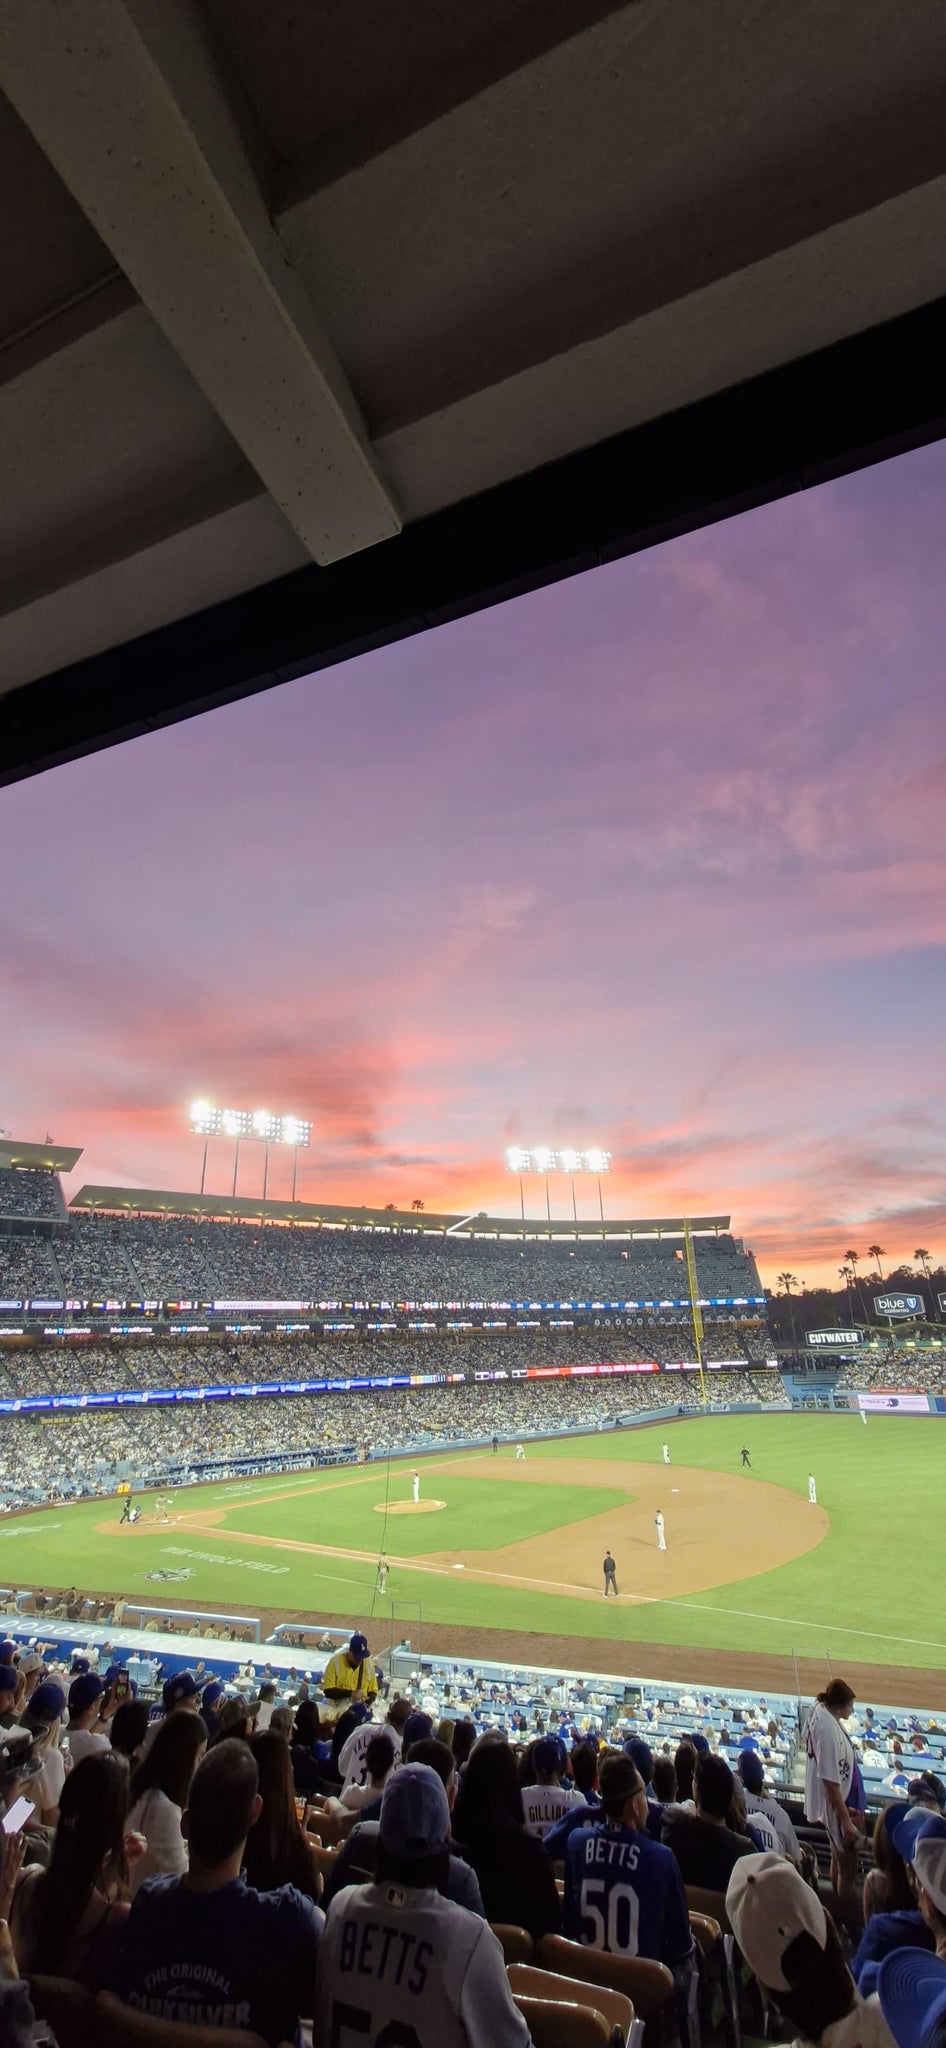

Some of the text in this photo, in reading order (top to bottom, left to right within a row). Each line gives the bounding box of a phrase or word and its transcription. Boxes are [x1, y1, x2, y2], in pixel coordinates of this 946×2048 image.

[878, 1298, 904, 1309] blue
[808, 1332, 859, 1344] CUTWATER
[239, 1561, 290, 1574] FIELD
[1, 1620, 104, 1639] DODGER
[586, 1839, 641, 1870] BETTS
[581, 1878, 640, 1957] 50
[339, 1921, 434, 1996] BETTS
[144, 1963, 232, 1995] THE ORIGINAL
